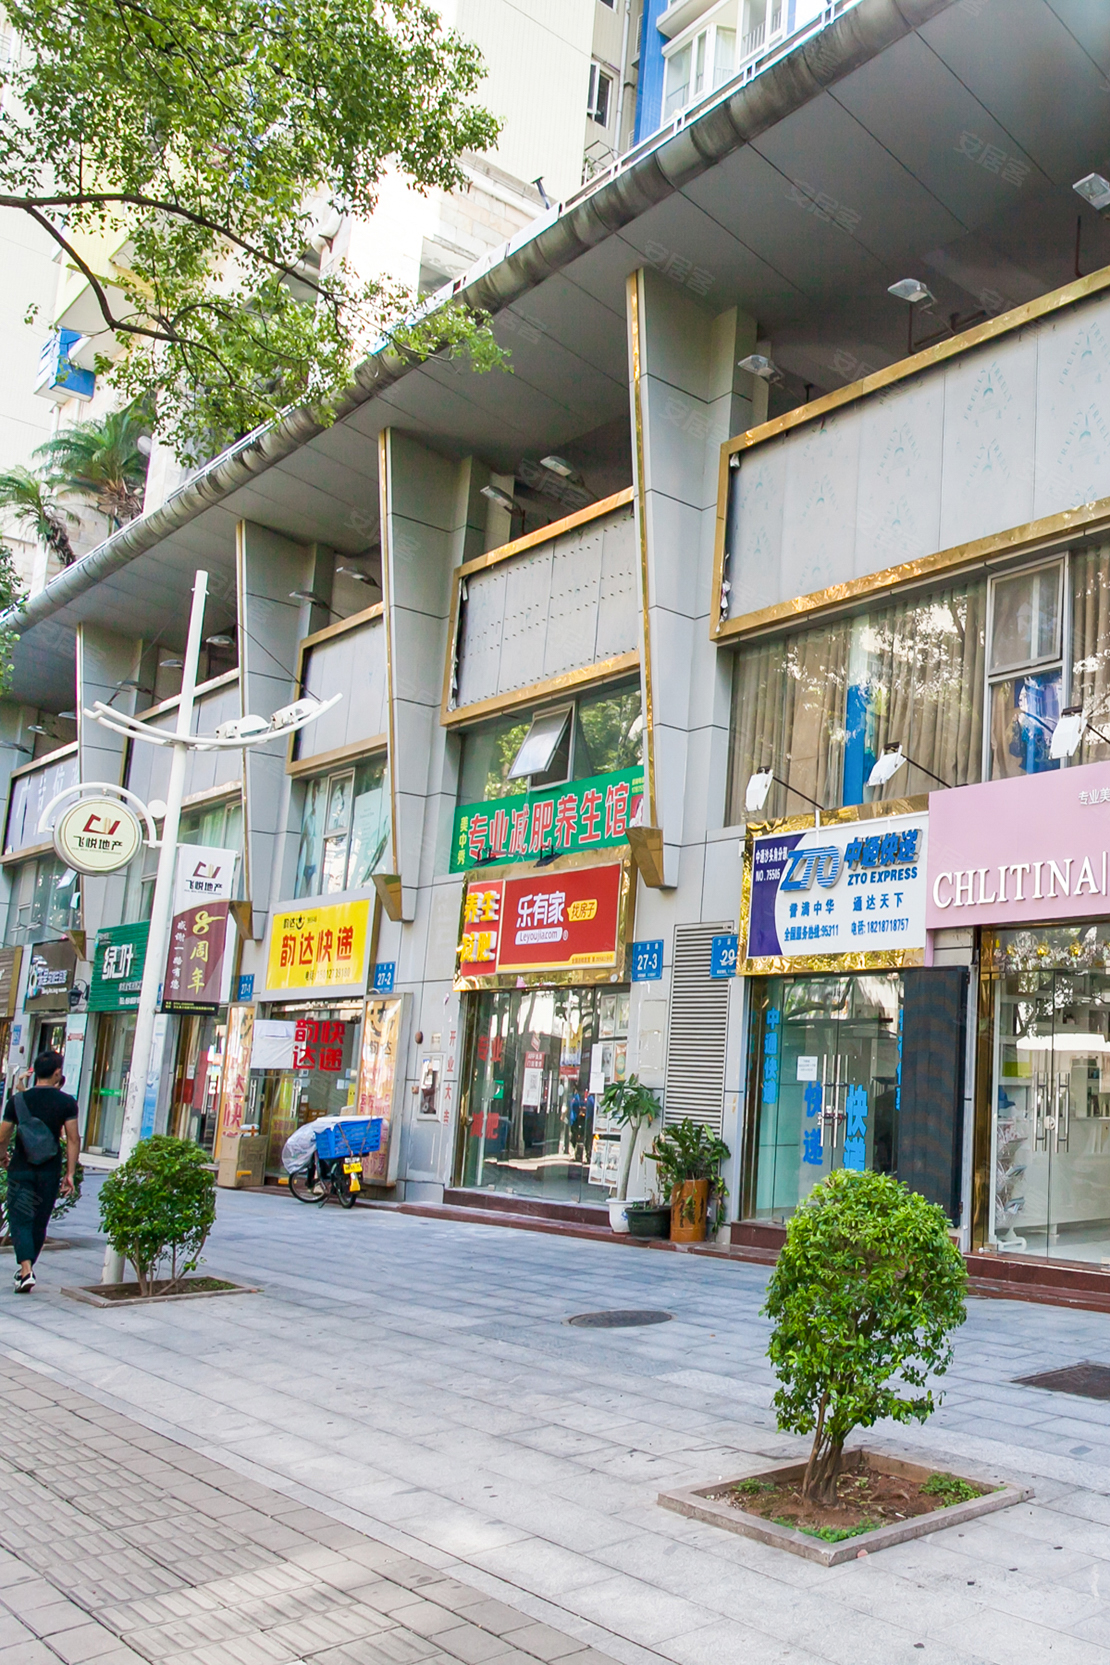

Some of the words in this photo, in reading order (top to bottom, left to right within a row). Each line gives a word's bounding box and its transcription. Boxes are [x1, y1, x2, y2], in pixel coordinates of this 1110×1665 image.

[468, 782, 630, 861] 专业减肥养生馆
[73, 835, 123, 851] 飞悦地产
[456, 816, 469, 866] 美中秀
[845, 829, 921, 869] 中通快递
[780, 845, 842, 891] ZTO
[848, 872, 868, 886] ZTO
[870, 867, 918, 884] EXPRESS
[932, 856, 1099, 909] CHLITINA
[185, 879, 223, 893] 飞悦地产
[464, 890, 499, 923] 养生
[516, 891, 566, 928] 乐有家
[570, 903, 597, 919] 找房子
[789, 897, 836, 919] 誉满中华
[853, 892, 905, 912] 通达天下
[280, 925, 354, 967] 韵达快递
[460, 931, 496, 964] 减肥
[784, 924, 839, 942] 全国服务热线:95311
[102, 943, 134, 980] 绿叶
[169, 919, 188, 990] 感谢一路有您
[187, 910, 226, 995] 8周年
[636, 953, 658, 971] 27-3
[377, 972, 392, 986] 27-2
